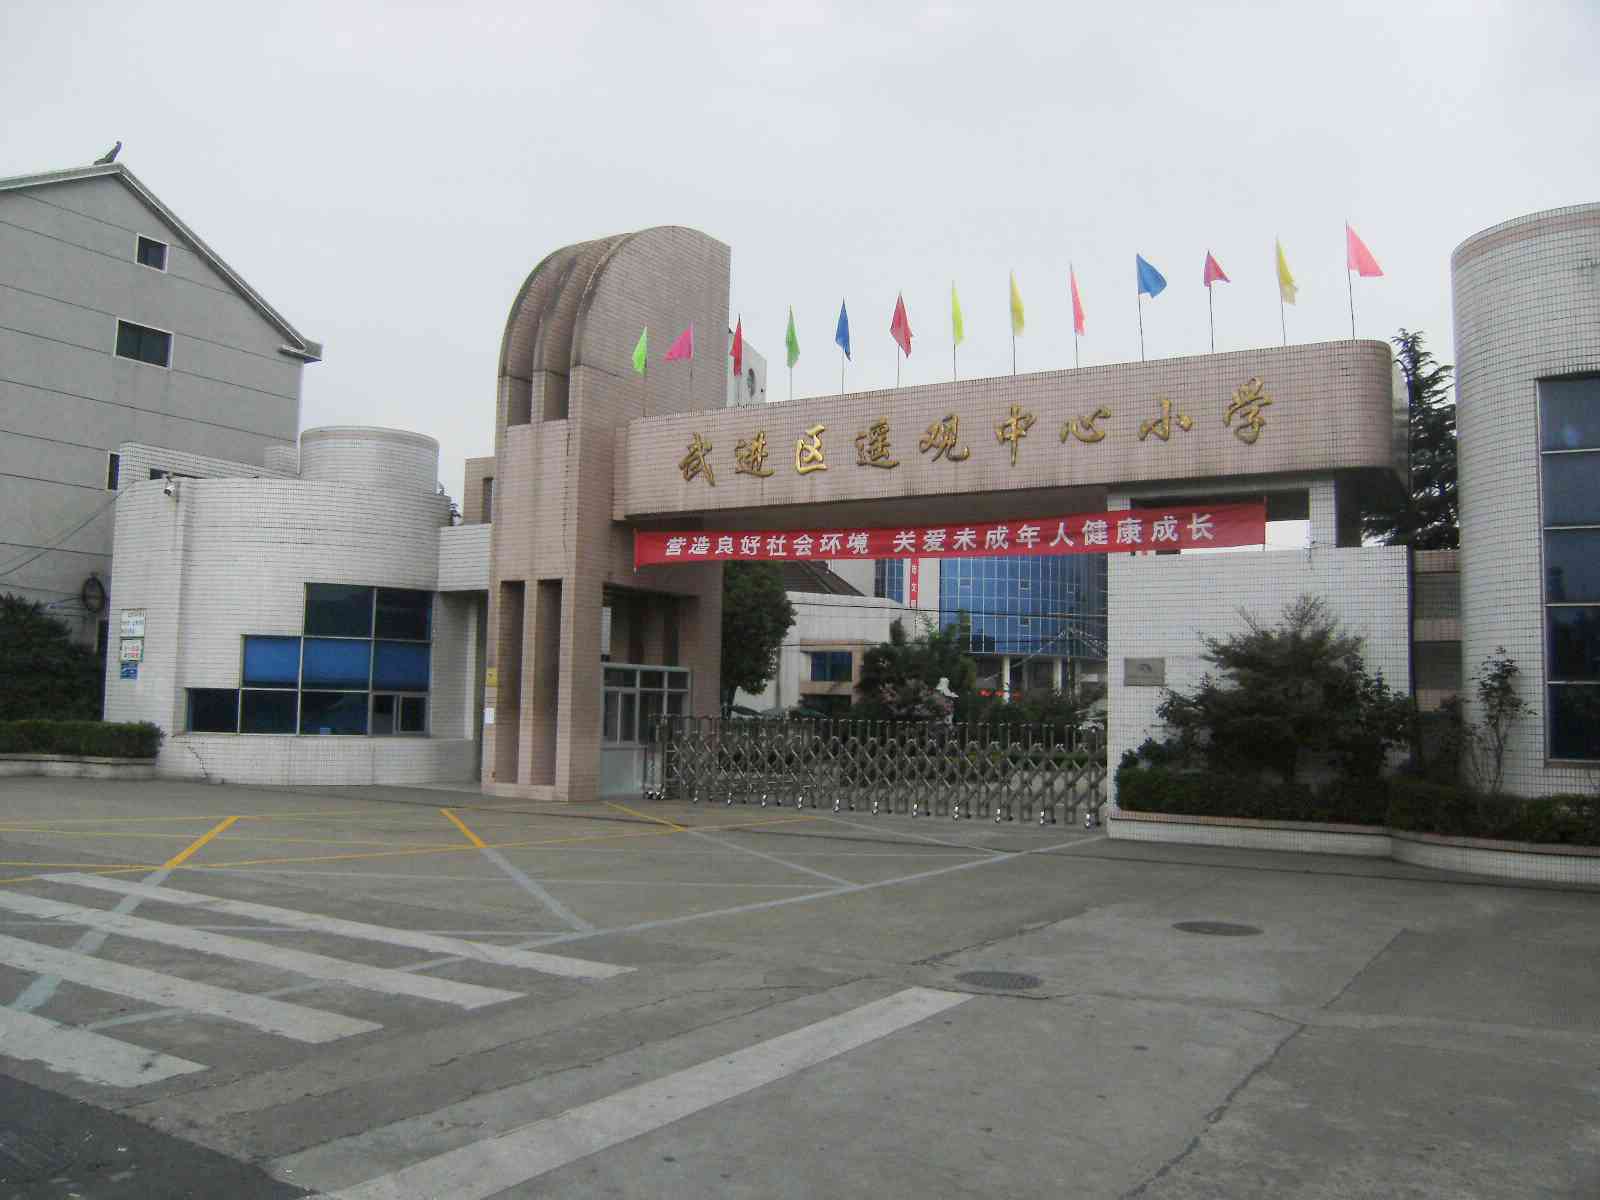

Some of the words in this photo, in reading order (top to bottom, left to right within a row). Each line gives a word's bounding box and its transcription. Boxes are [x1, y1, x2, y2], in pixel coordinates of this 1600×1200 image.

[679, 375, 1273, 487] 武进区遥观中心小学
[665, 532, 870, 556] 营造良好社会环境
[892, 513, 1215, 553] 关爱未成年人健康成长
